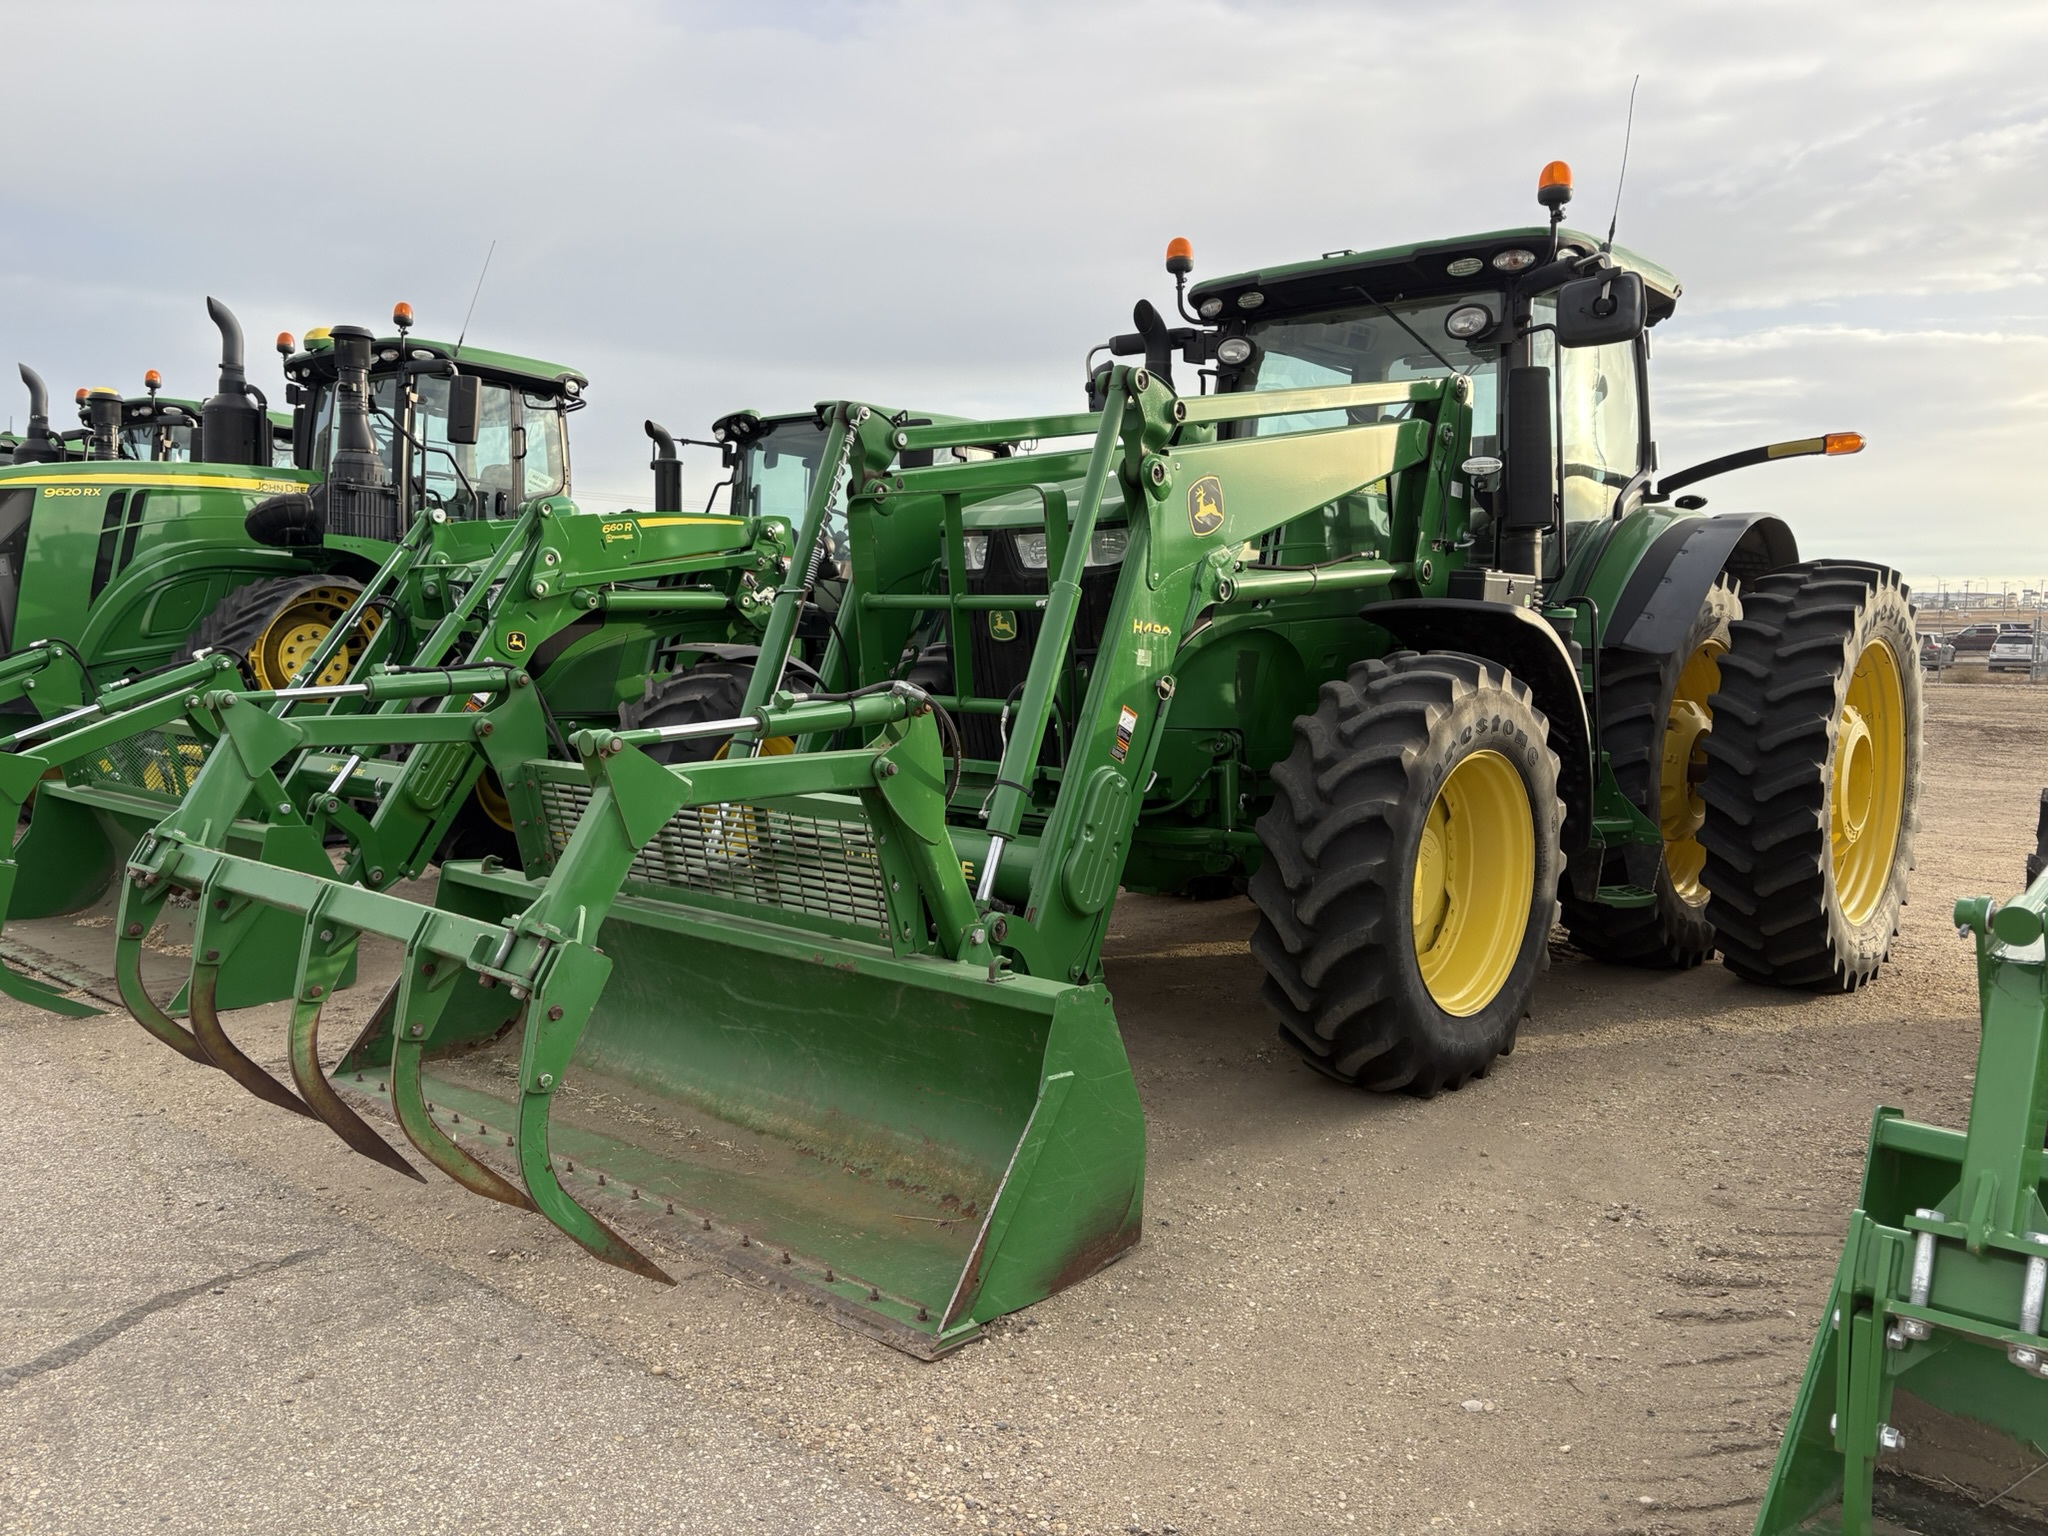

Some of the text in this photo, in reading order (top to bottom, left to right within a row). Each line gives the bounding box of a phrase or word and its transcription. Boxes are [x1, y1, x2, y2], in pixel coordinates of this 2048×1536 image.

[43, 488, 102, 498] 9620 RX
[255, 482, 308, 495] JOHN DEE
[602, 522, 632, 534] 660 R
